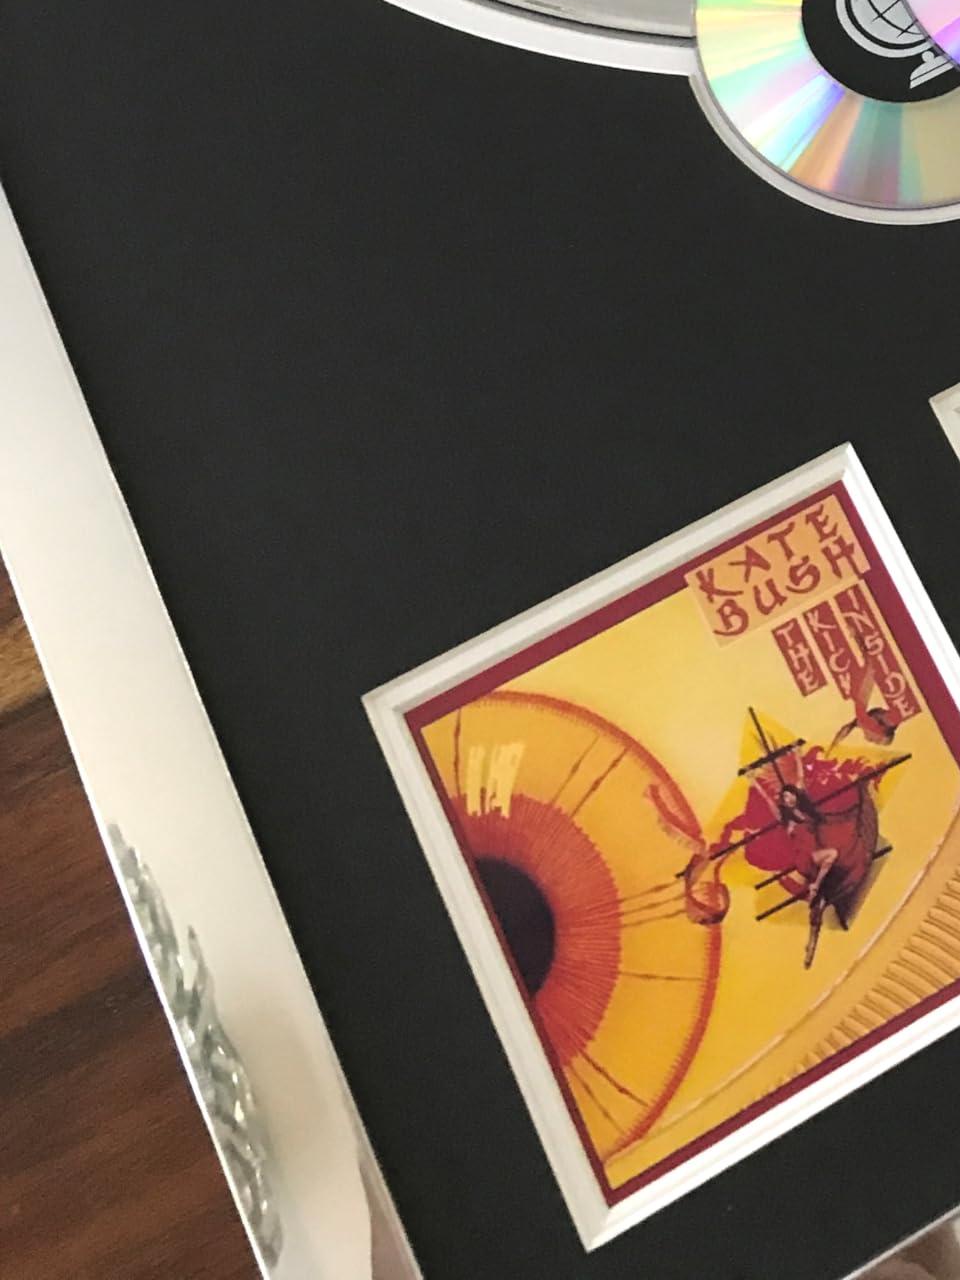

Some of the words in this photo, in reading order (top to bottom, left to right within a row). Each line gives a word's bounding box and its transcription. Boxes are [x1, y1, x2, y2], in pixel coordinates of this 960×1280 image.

[695, 504, 838, 603] KATE
[713, 536, 866, 637] BUSH
[776, 622, 820, 693] THE
[840, 588, 916, 718] INSIDE
